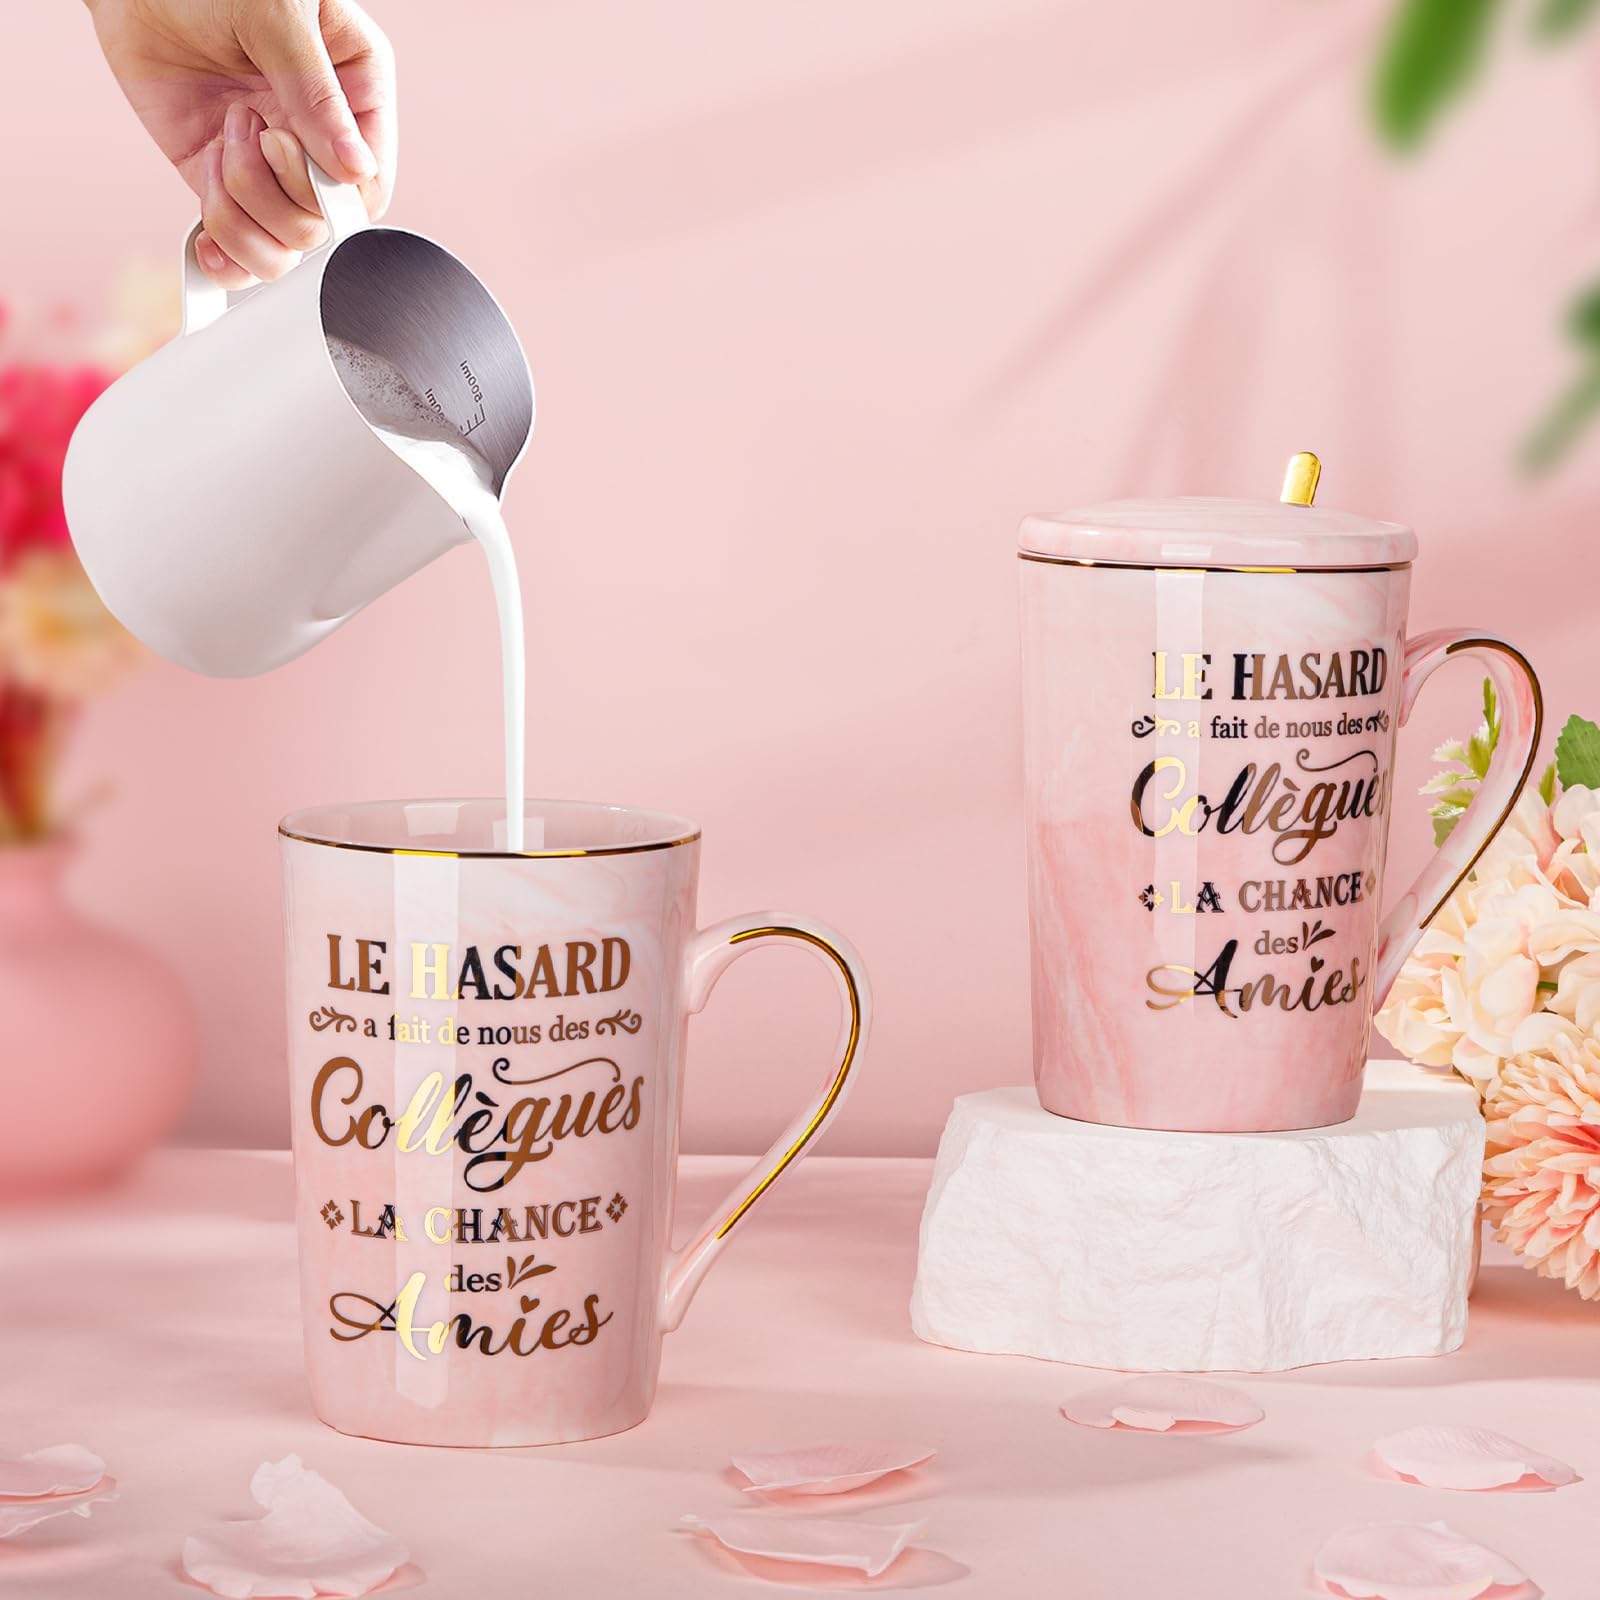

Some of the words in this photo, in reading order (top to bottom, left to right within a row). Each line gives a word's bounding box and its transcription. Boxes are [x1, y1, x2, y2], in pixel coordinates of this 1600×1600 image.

[1152, 651, 1212, 701] LE
[1231, 647, 1388, 701] HASARD
[1187, 720, 1200, 738] a
[1210, 715, 1248, 740] fait
[1254, 715, 1280, 739] de
[1285, 718, 1332, 739] nous
[1336, 713, 1363, 736] des
[1170, 880, 1225, 914] LA
[1238, 871, 1364, 912] CHANCE
[327, 934, 390, 995] LE
[409, 937, 631, 1001] HASARD
[1254, 930, 1299, 956] des
[1145, 939, 1365, 1019] Amies
[364, 1018, 377, 1038] a
[388, 1014, 431, 1045] fait
[437, 1017, 470, 1046] de
[477, 1023, 541, 1046] nous
[549, 1014, 590, 1043] des
[311, 1056, 645, 1193] Collègues
[351, 1200, 408, 1243] LA
[424, 1196, 604, 1245] CHANCE
[444, 1264, 502, 1295] des
[329, 1271, 614, 1361] Amies
